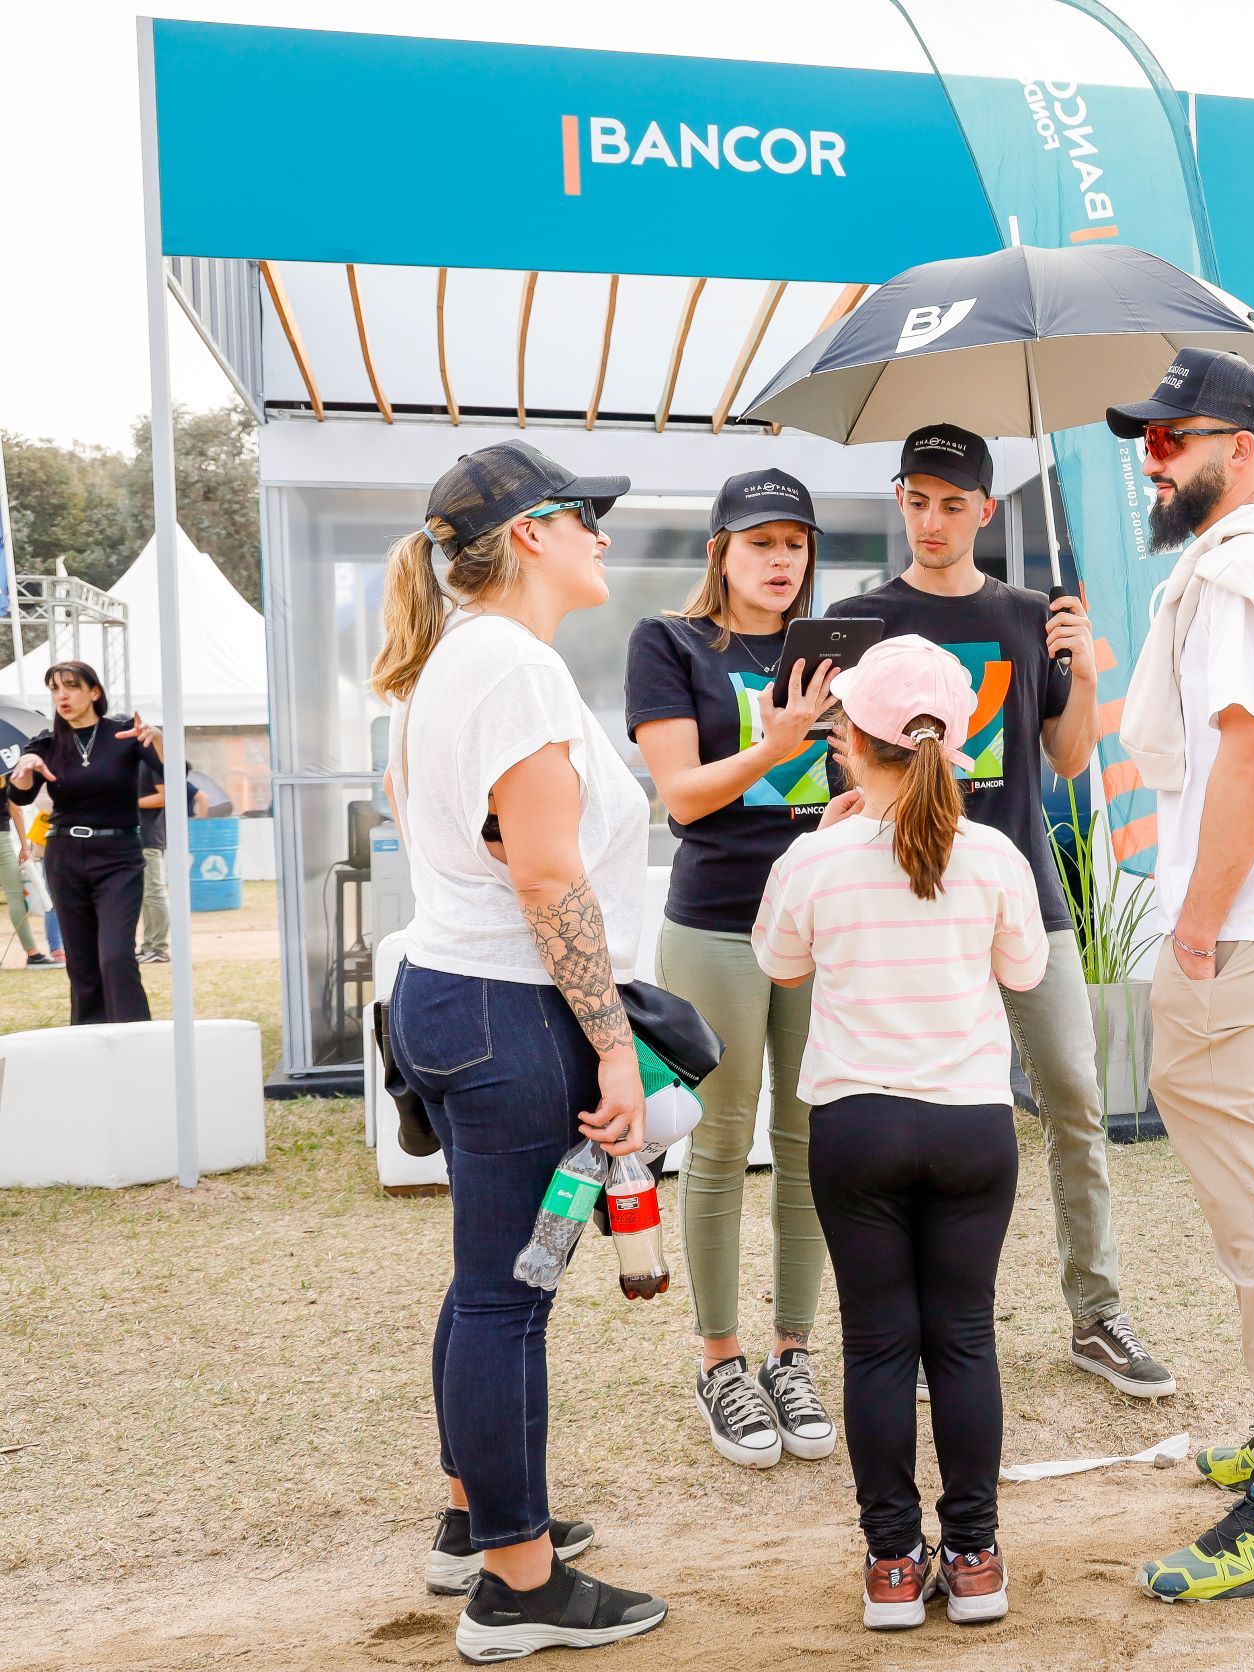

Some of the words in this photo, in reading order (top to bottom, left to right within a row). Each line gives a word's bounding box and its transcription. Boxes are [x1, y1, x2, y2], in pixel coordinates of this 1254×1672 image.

[590, 116, 847, 177] BANCOR
[974, 779, 1004, 789] BANCOR
[794, 806, 826, 815] BANCO
